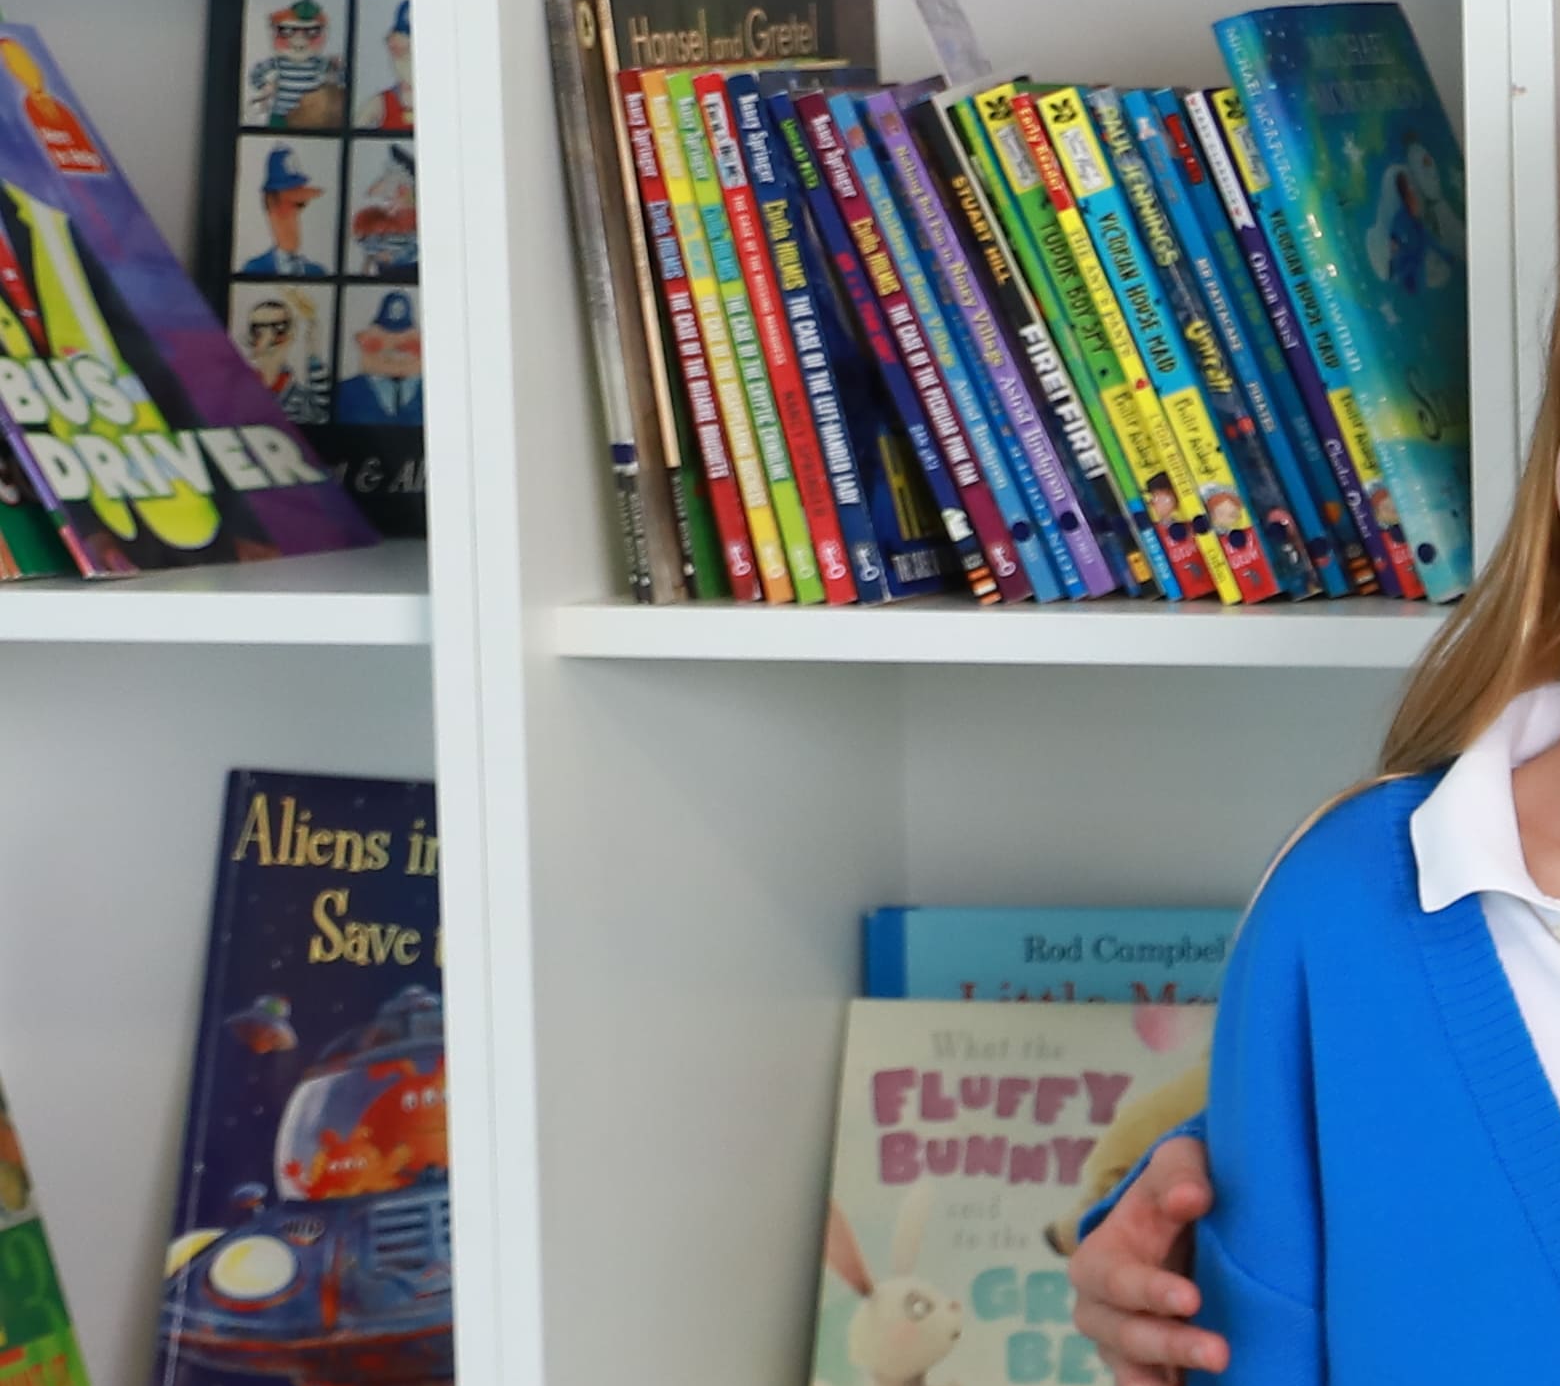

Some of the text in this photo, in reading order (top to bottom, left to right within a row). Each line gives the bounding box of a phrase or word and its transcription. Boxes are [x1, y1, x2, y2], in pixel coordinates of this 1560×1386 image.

[628, 2, 819, 65] Hansel and Gretel
[952, 175, 1010, 285] STUART HILL
[1, 355, 134, 427] BUS
[25, 425, 328, 499] DRIVER
[231, 793, 391, 874] Aliens
[309, 889, 420, 964] Save
[1024, 935, 1226, 969] Rod Campbel
